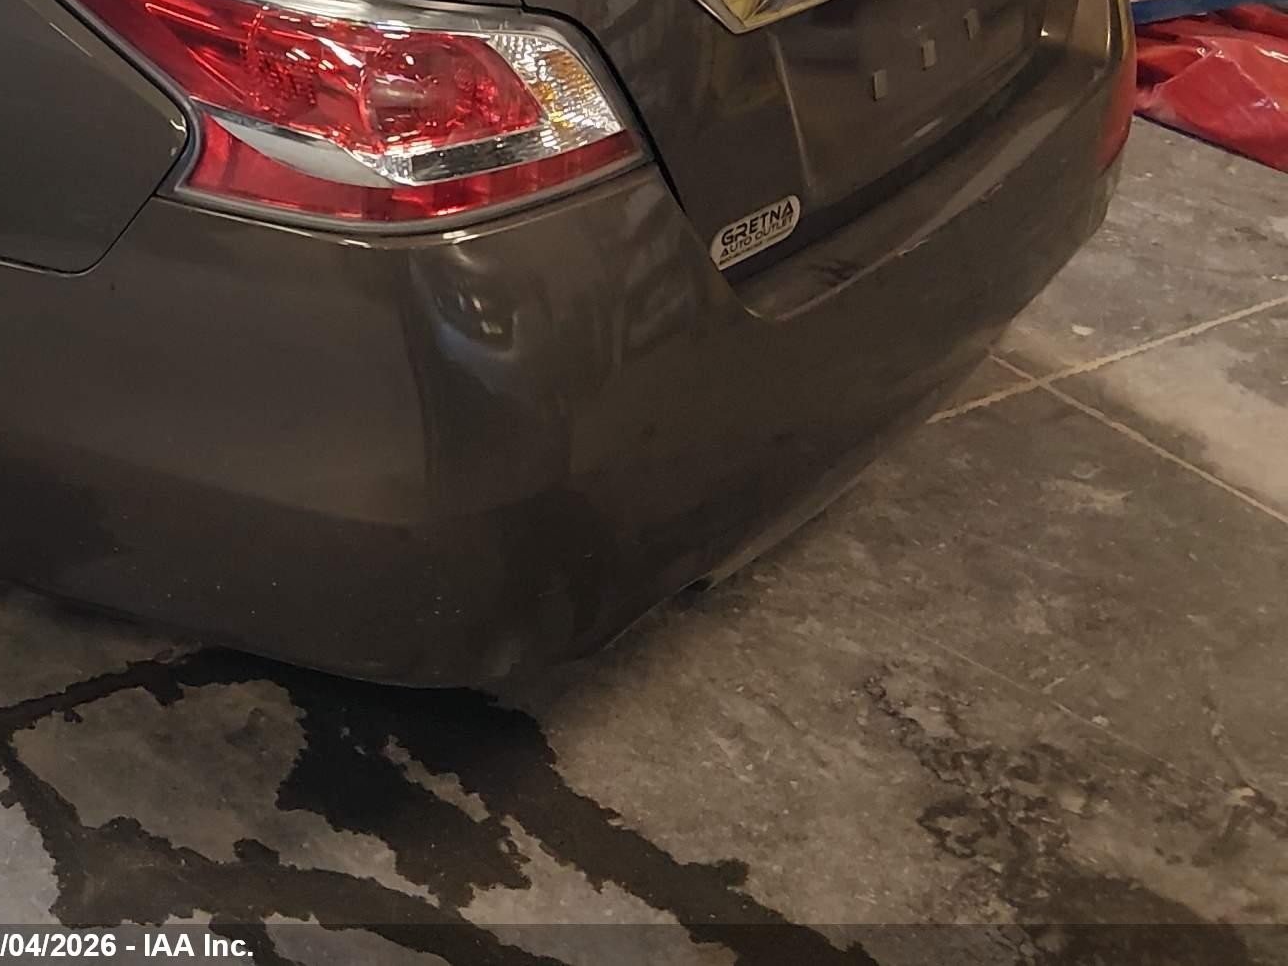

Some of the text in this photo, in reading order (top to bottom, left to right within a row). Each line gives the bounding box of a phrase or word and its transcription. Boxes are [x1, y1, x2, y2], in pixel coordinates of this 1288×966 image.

[719, 236, 753, 258] AUTO
[754, 215, 793, 241] OUTLET
[721, 200, 794, 247] GRETNA
